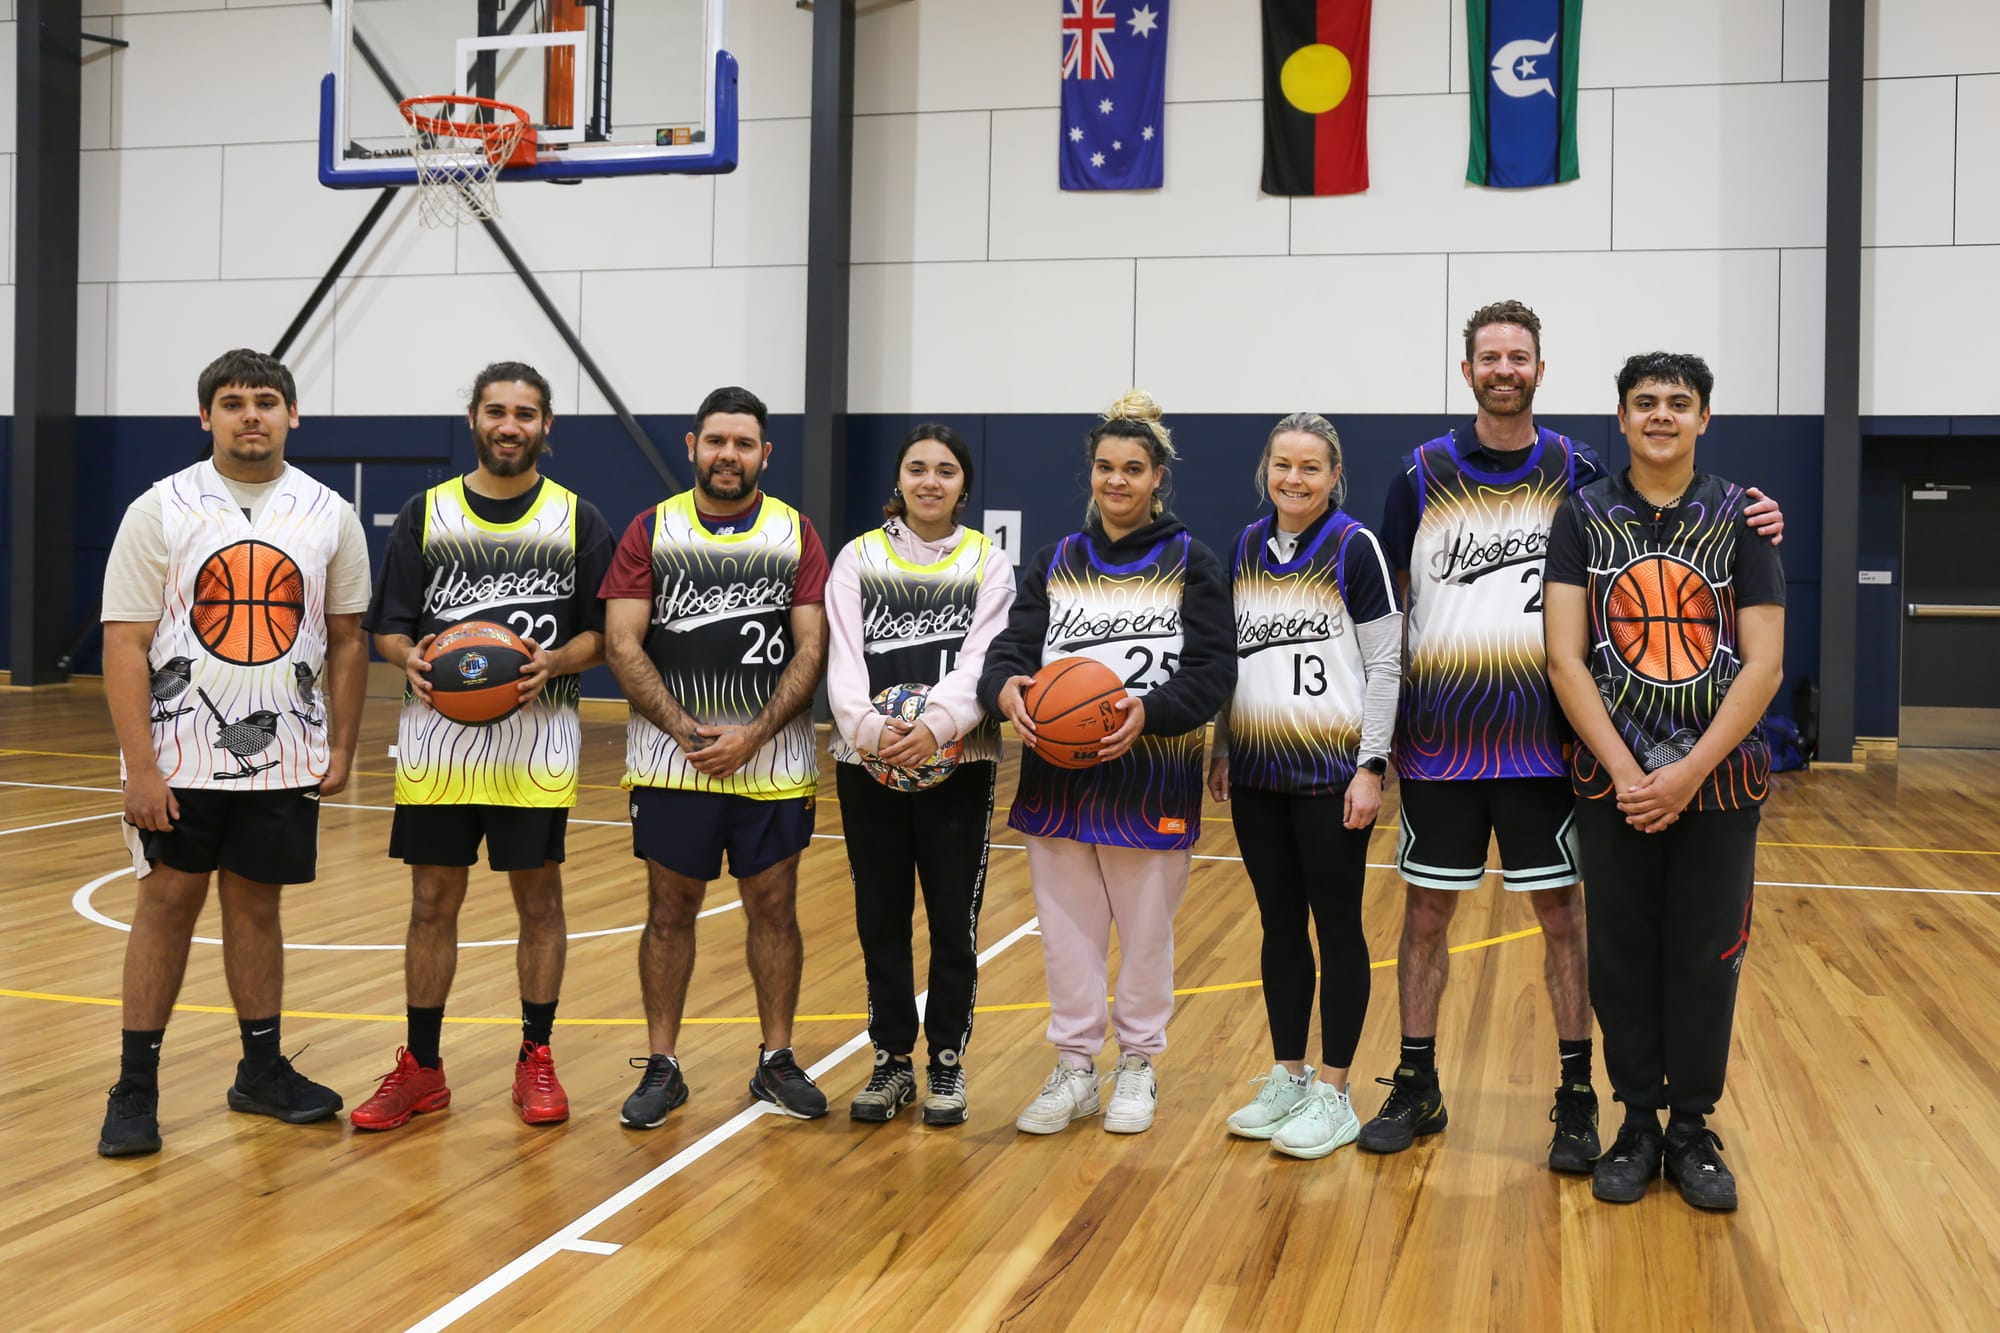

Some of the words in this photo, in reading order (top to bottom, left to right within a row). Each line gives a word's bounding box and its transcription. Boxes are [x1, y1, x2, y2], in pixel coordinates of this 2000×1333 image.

[995, 525, 1007, 550] 1
[424, 563, 576, 615] Hoopers
[740, 620, 785, 665] 26
[1048, 604, 1178, 646] Hoopers
[1124, 646, 1179, 690] 25
[1293, 653, 1328, 696] 13
